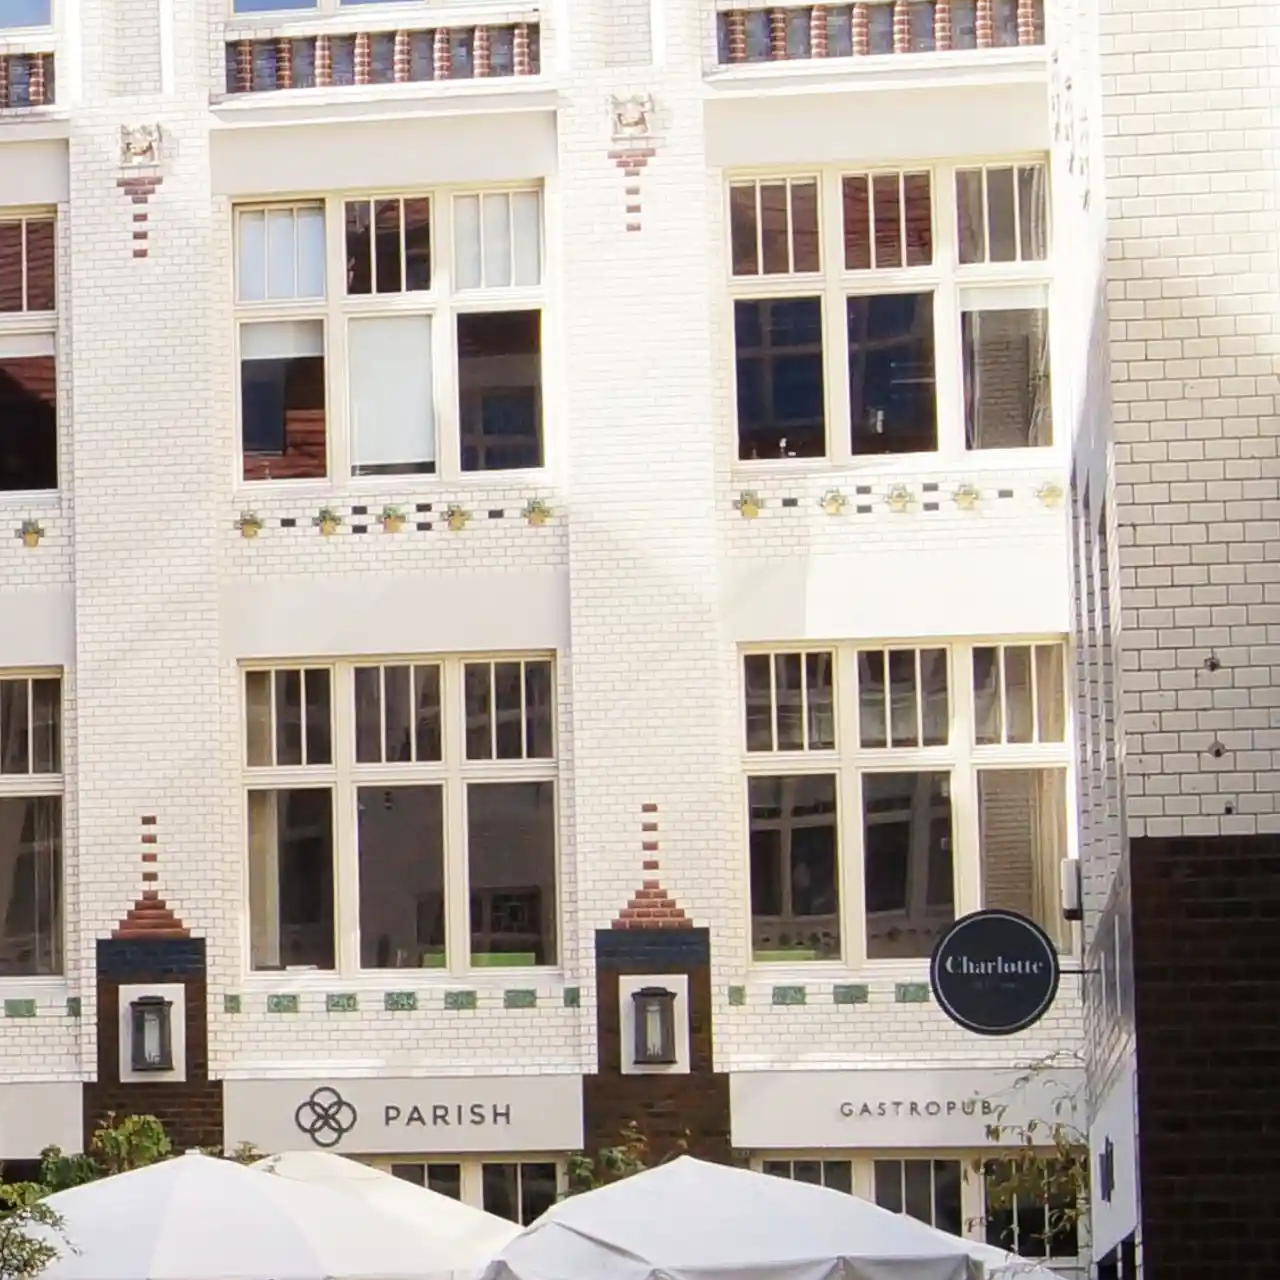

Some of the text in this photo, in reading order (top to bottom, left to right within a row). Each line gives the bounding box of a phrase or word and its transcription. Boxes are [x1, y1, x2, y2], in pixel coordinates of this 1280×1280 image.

[945, 955, 1043, 974] Charlotte
[384, 1103, 512, 1127] PARISH
[840, 1100, 993, 1118] GASTROPUB
